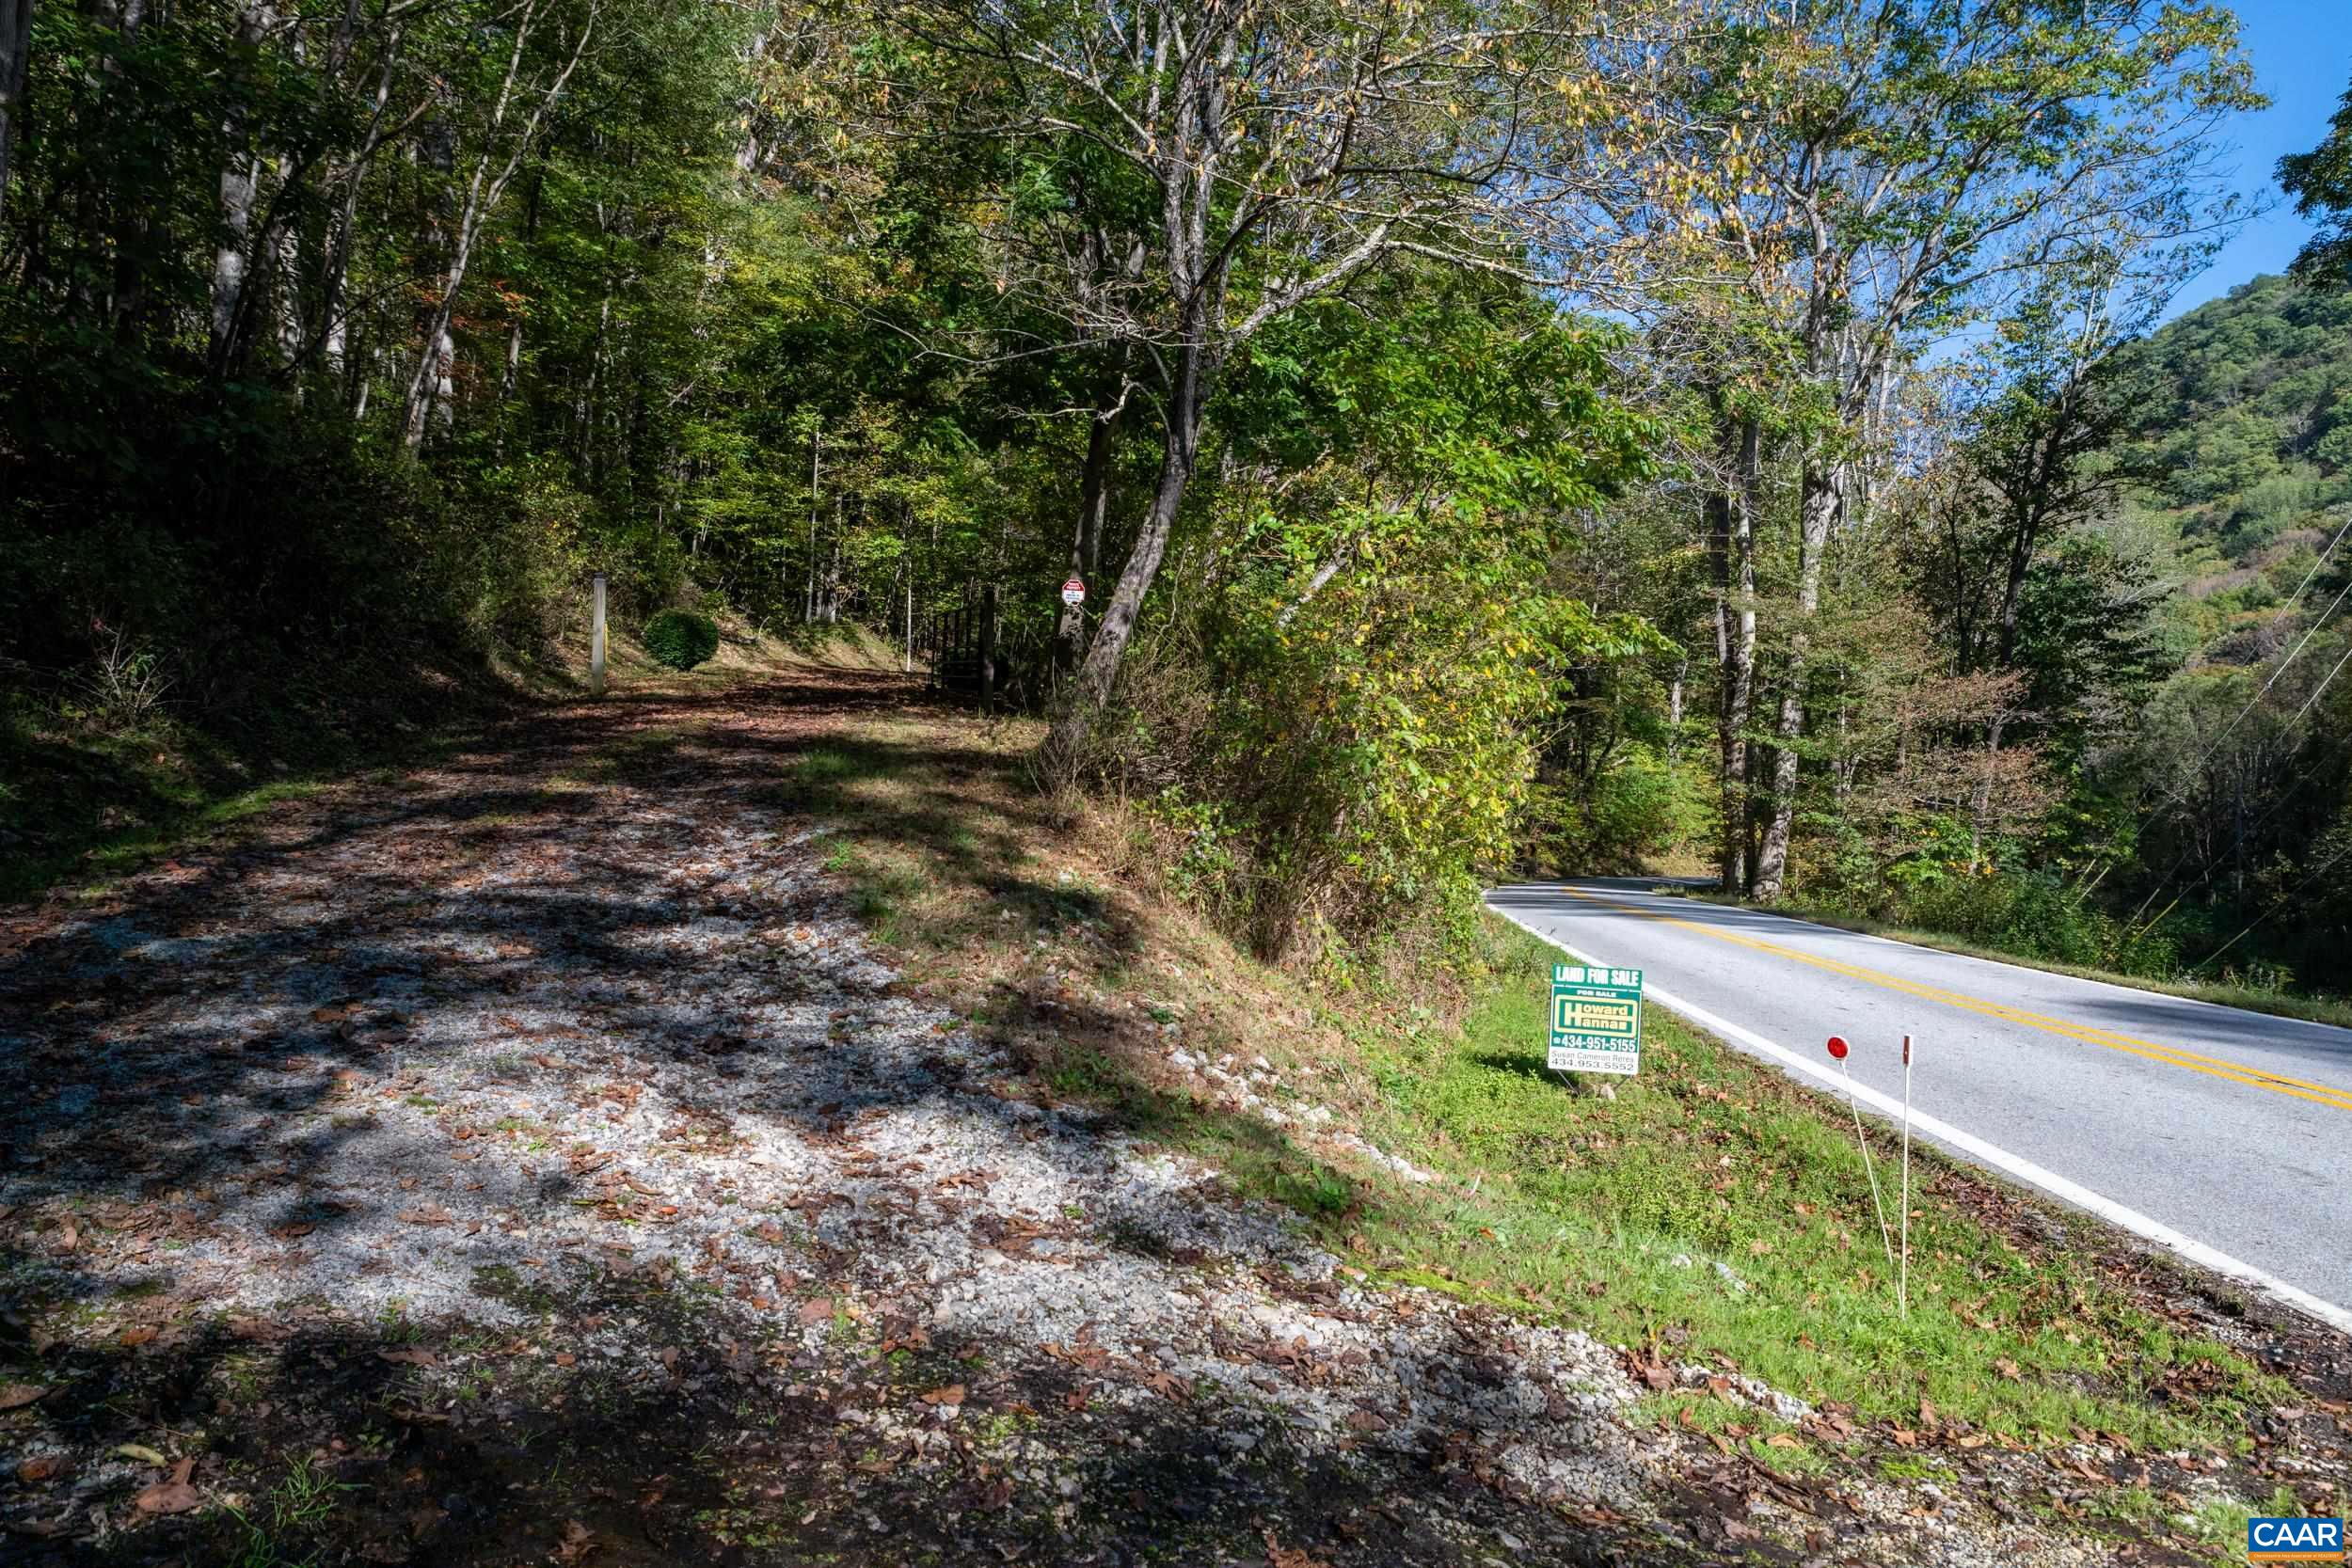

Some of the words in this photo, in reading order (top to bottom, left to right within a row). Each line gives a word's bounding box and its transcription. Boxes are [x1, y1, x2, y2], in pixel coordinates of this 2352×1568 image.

[1555, 965, 1585, 983] LAND
[1587, 968, 1609, 985] FOR
[1611, 970, 1639, 987] SALE
[1564, 1002, 1629, 1017] Howard
[1562, 1035, 1636, 1053] 434-951-5155
[1551, 1051, 1575, 1059] Susan
[1577, 1052, 1611, 1061] Cameron
